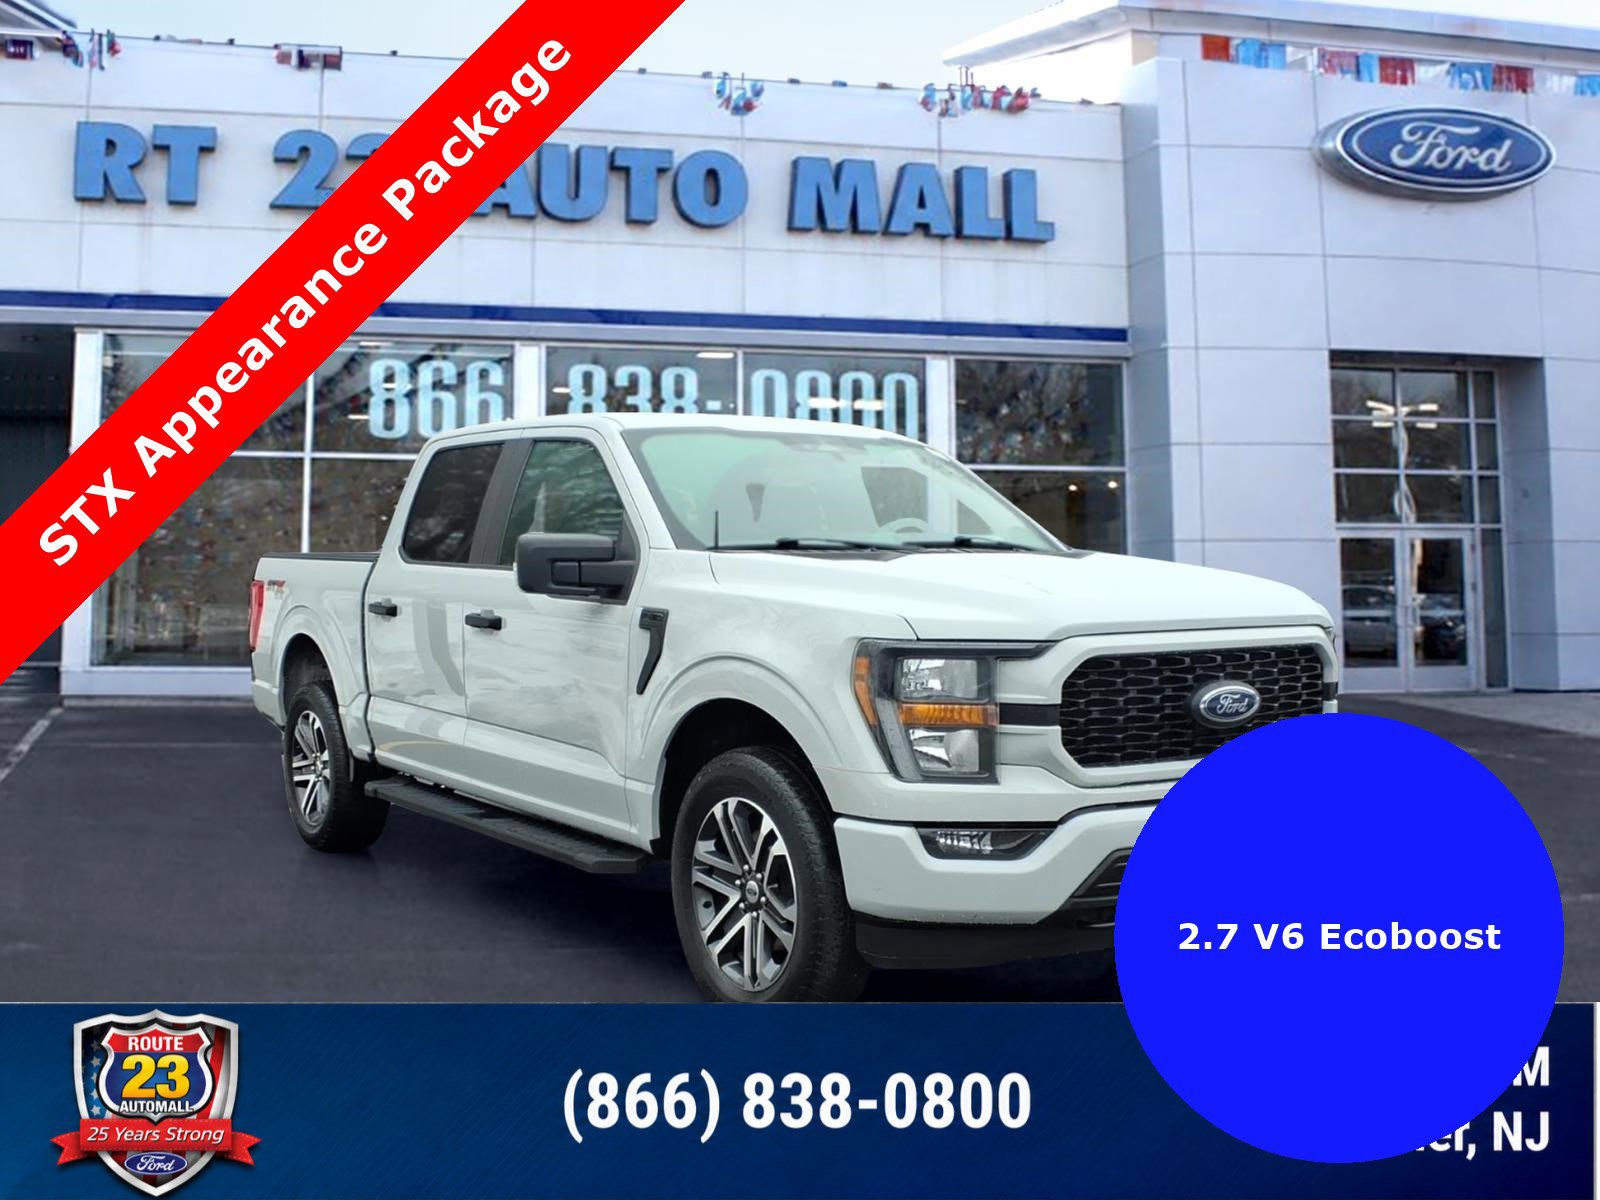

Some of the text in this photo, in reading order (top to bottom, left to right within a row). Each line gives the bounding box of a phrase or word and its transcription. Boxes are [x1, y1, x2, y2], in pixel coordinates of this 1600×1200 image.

[1389, 120, 1513, 172] Ford
[73, 120, 217, 205] RT
[787, 156, 1056, 243] MALL
[370, 358, 502, 439] 866
[1216, 694, 1248, 715] Ford
